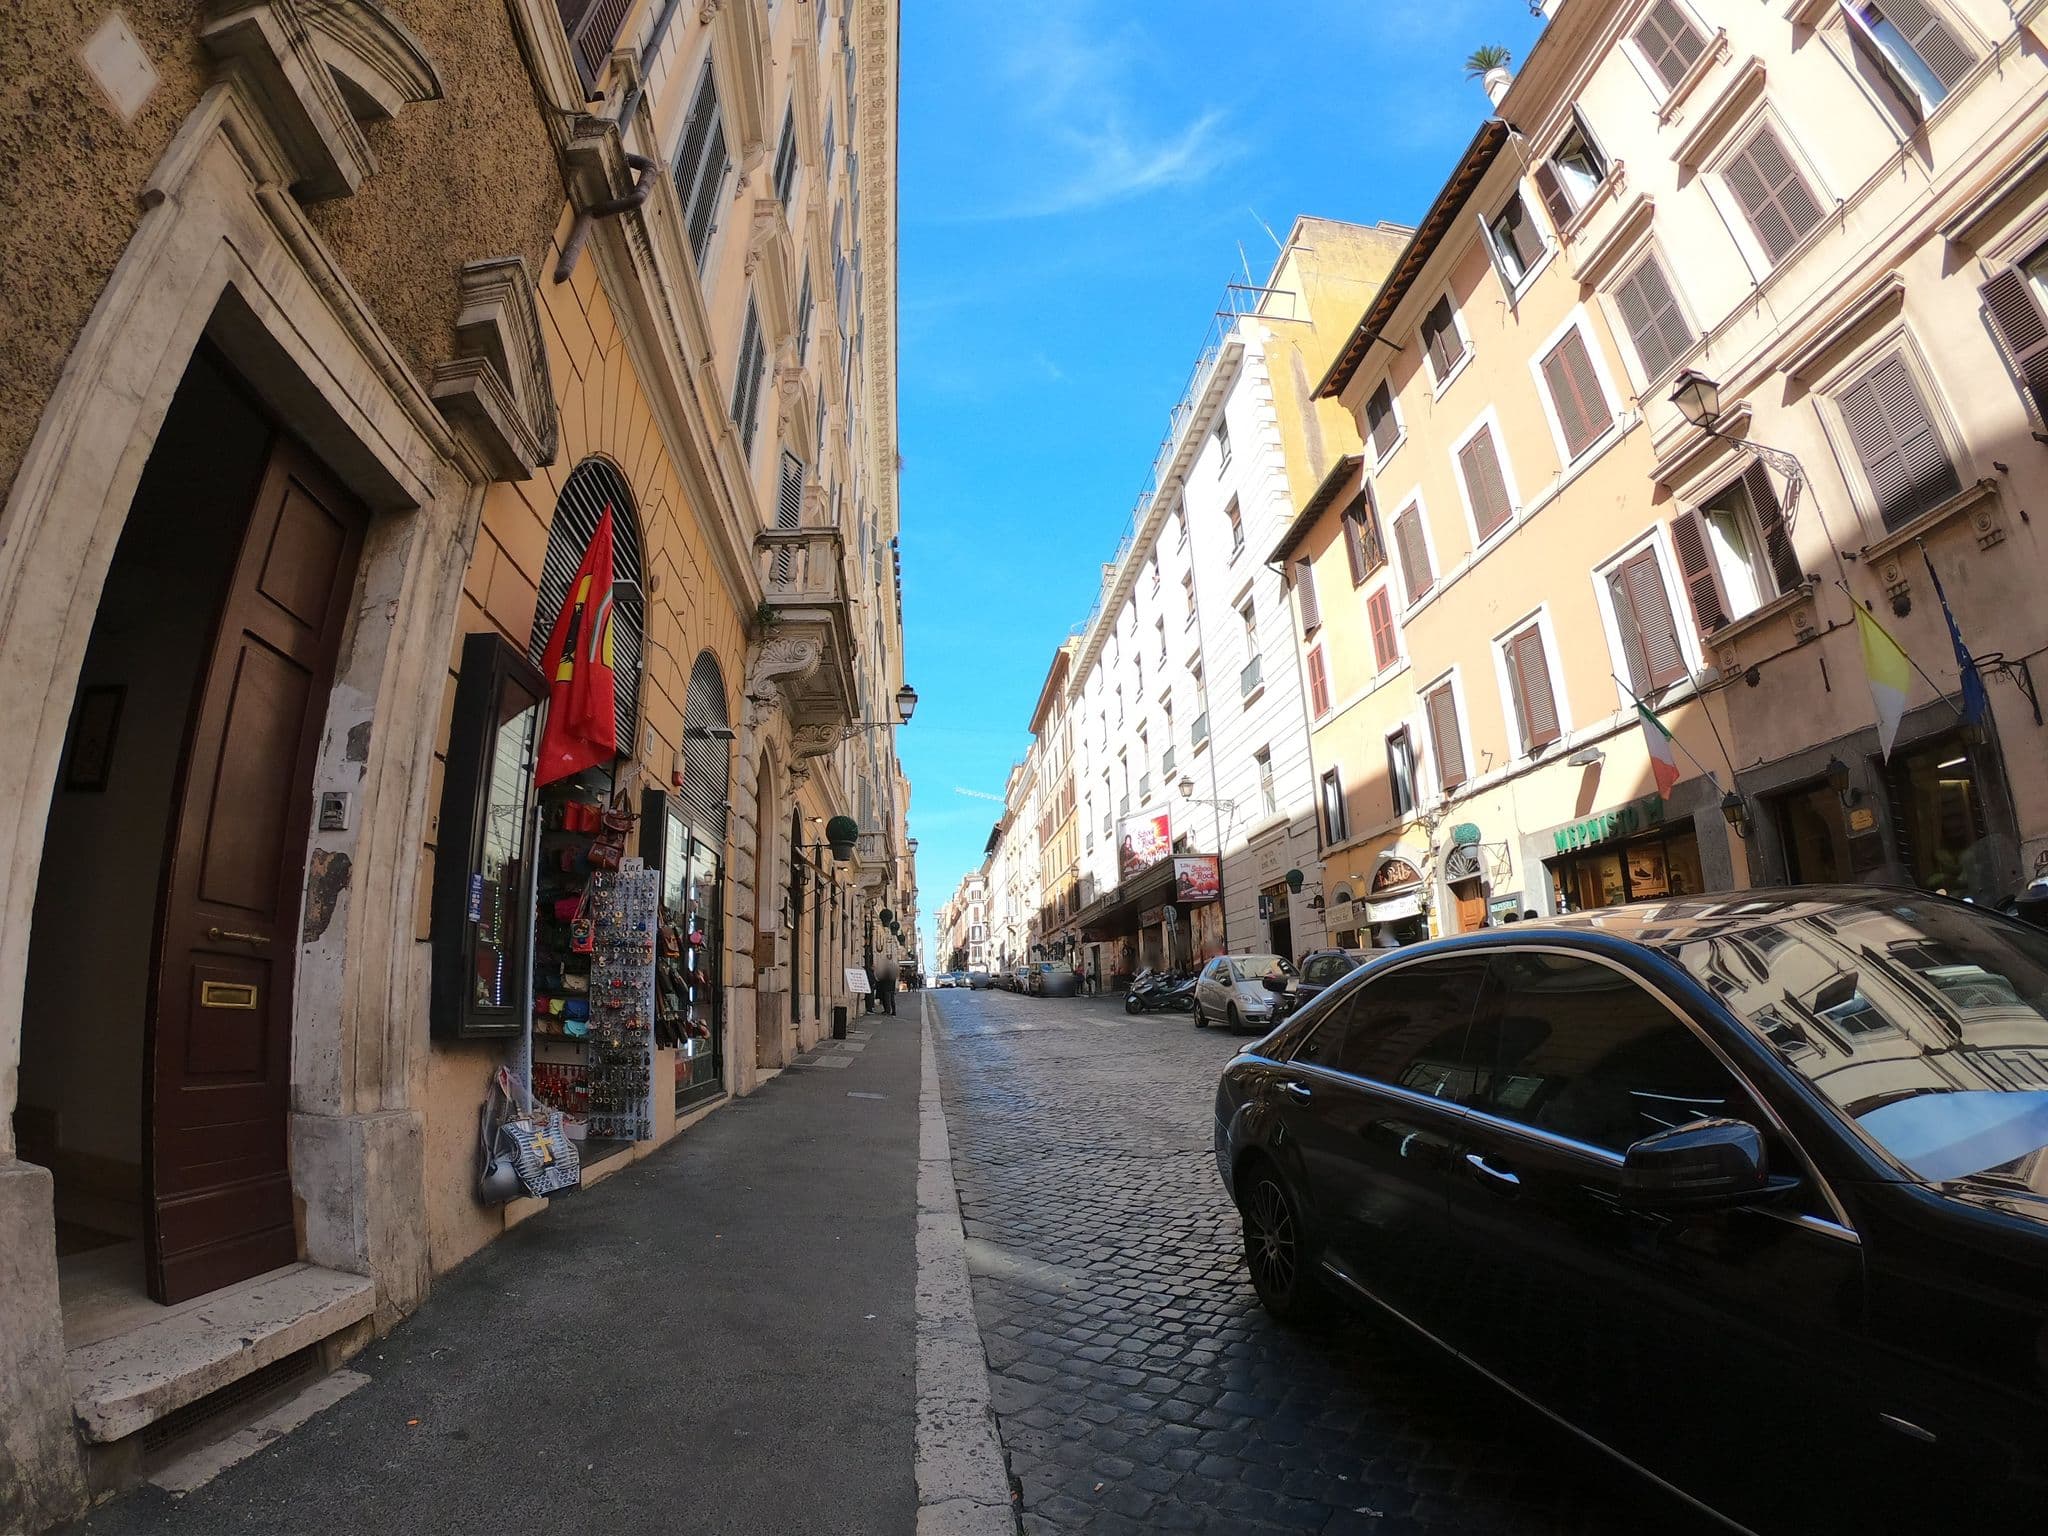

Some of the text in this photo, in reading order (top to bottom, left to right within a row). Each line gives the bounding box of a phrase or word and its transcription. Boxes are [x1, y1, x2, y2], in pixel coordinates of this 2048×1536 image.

[1553, 804, 1640, 853] MEPHISTO
[1191, 864, 1213, 872] School
[1197, 872, 1216, 880] Rock
